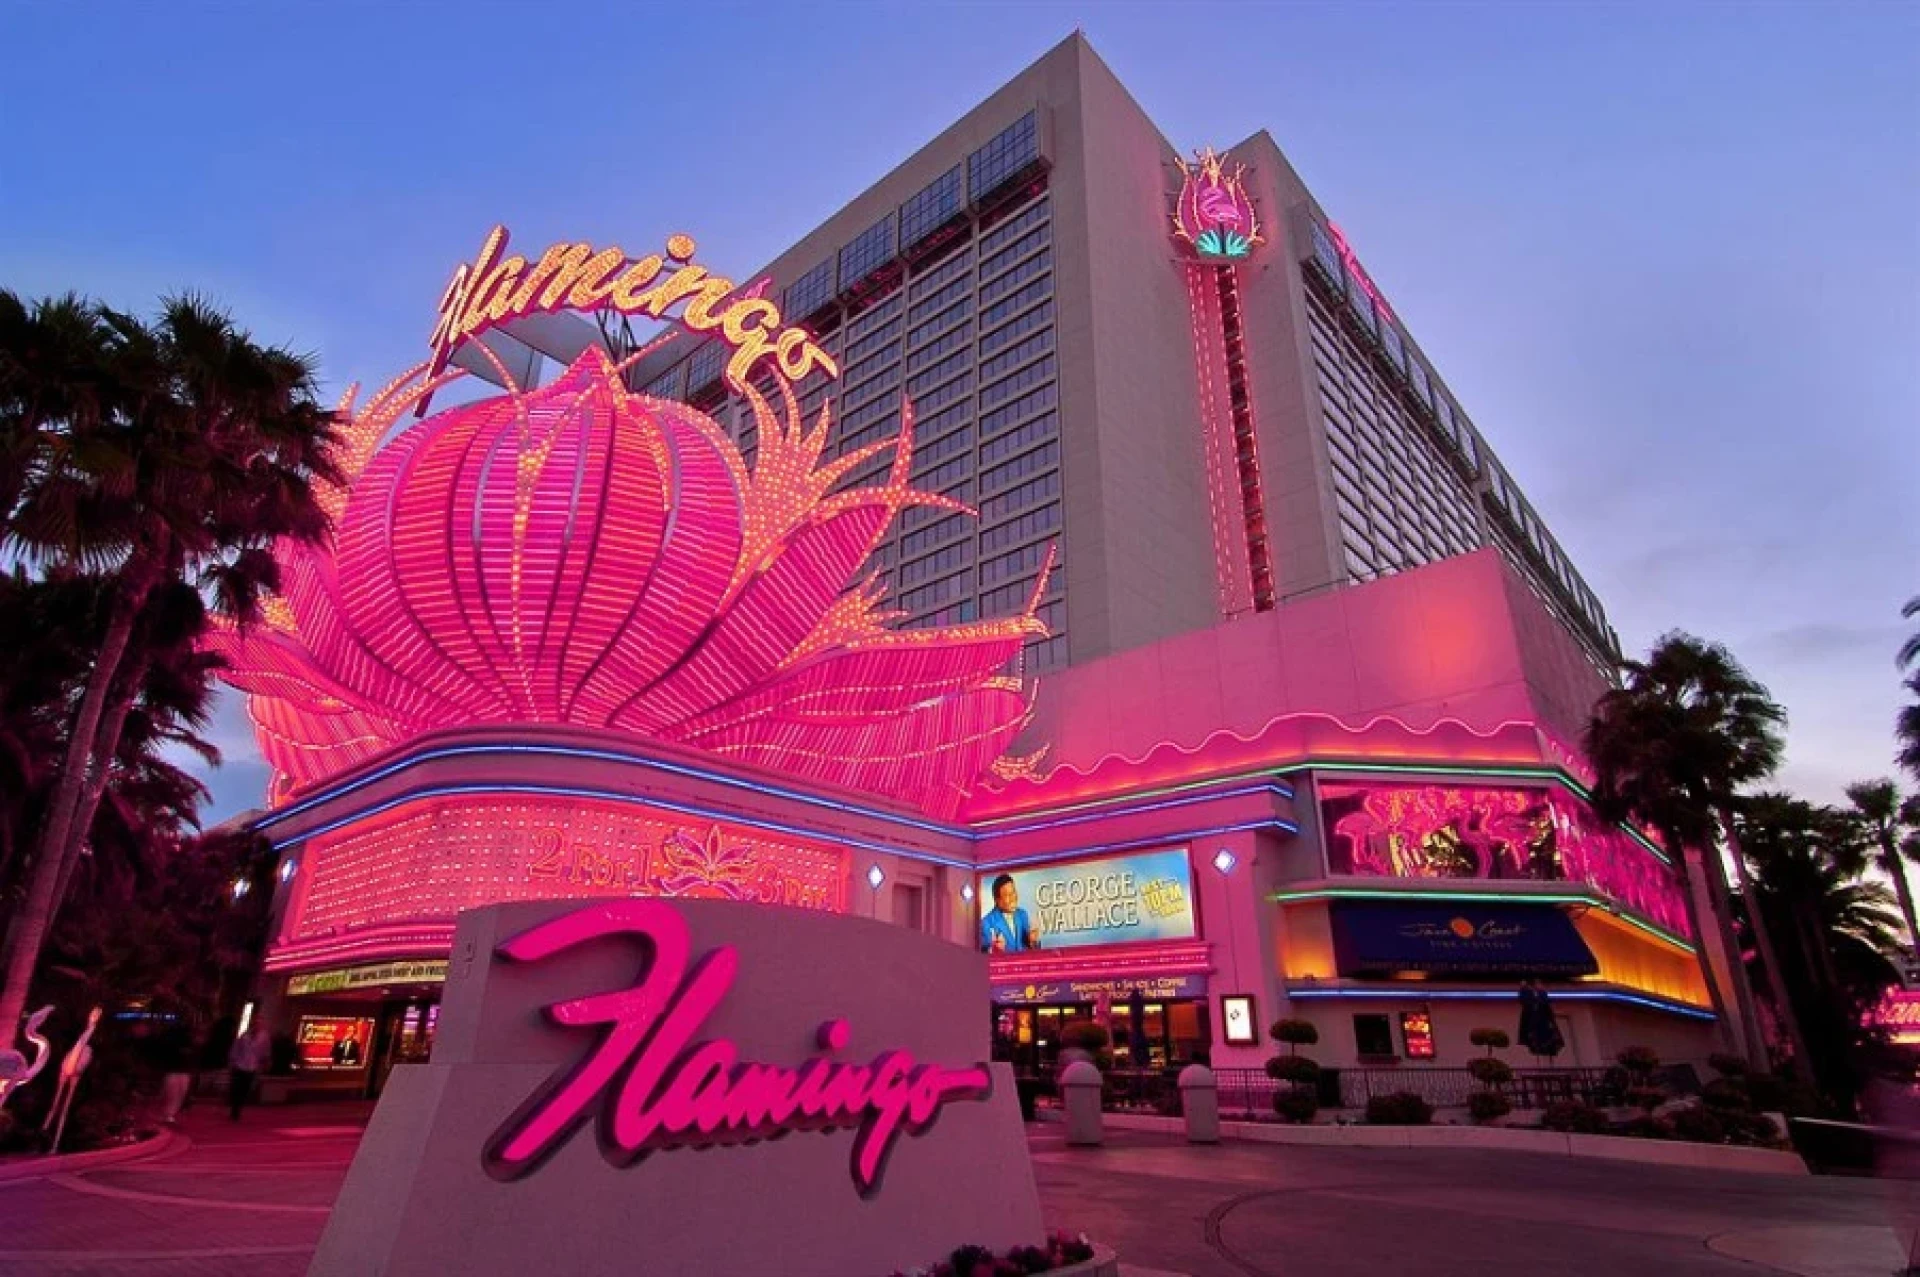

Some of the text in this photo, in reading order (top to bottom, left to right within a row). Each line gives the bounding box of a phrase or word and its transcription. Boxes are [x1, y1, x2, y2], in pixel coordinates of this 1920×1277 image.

[529, 828, 563, 878] 2
[1036, 871, 1138, 909] GEORGE
[1038, 900, 1140, 934] WALLACE
[498, 898, 990, 1189] Flamingo
